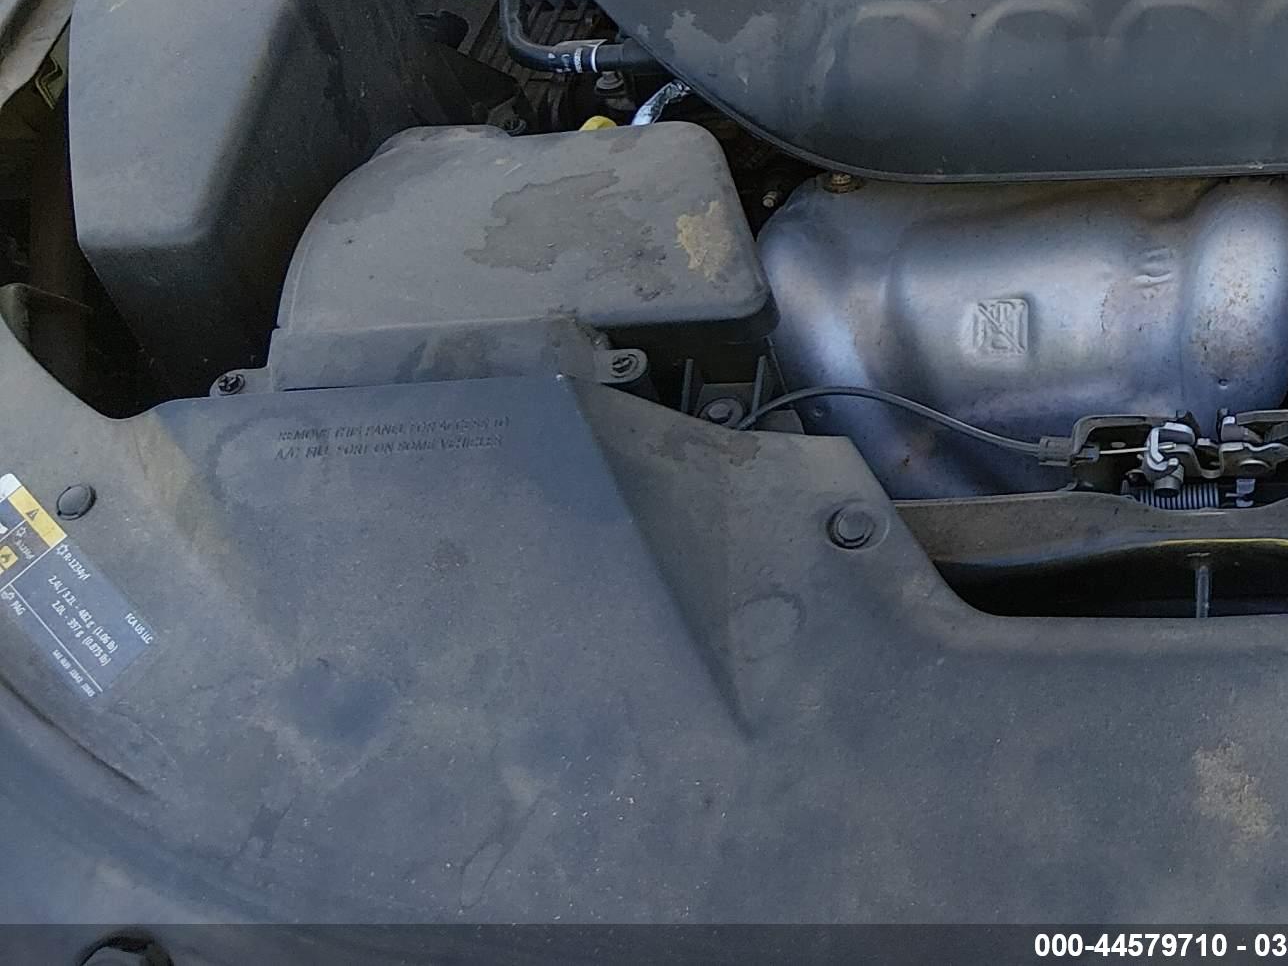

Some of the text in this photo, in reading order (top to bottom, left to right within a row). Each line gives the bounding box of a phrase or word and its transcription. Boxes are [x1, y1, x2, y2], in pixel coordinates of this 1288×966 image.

[63, 552, 90, 582] R-1234yf
[124, 612, 154, 645] FCA US LLC
